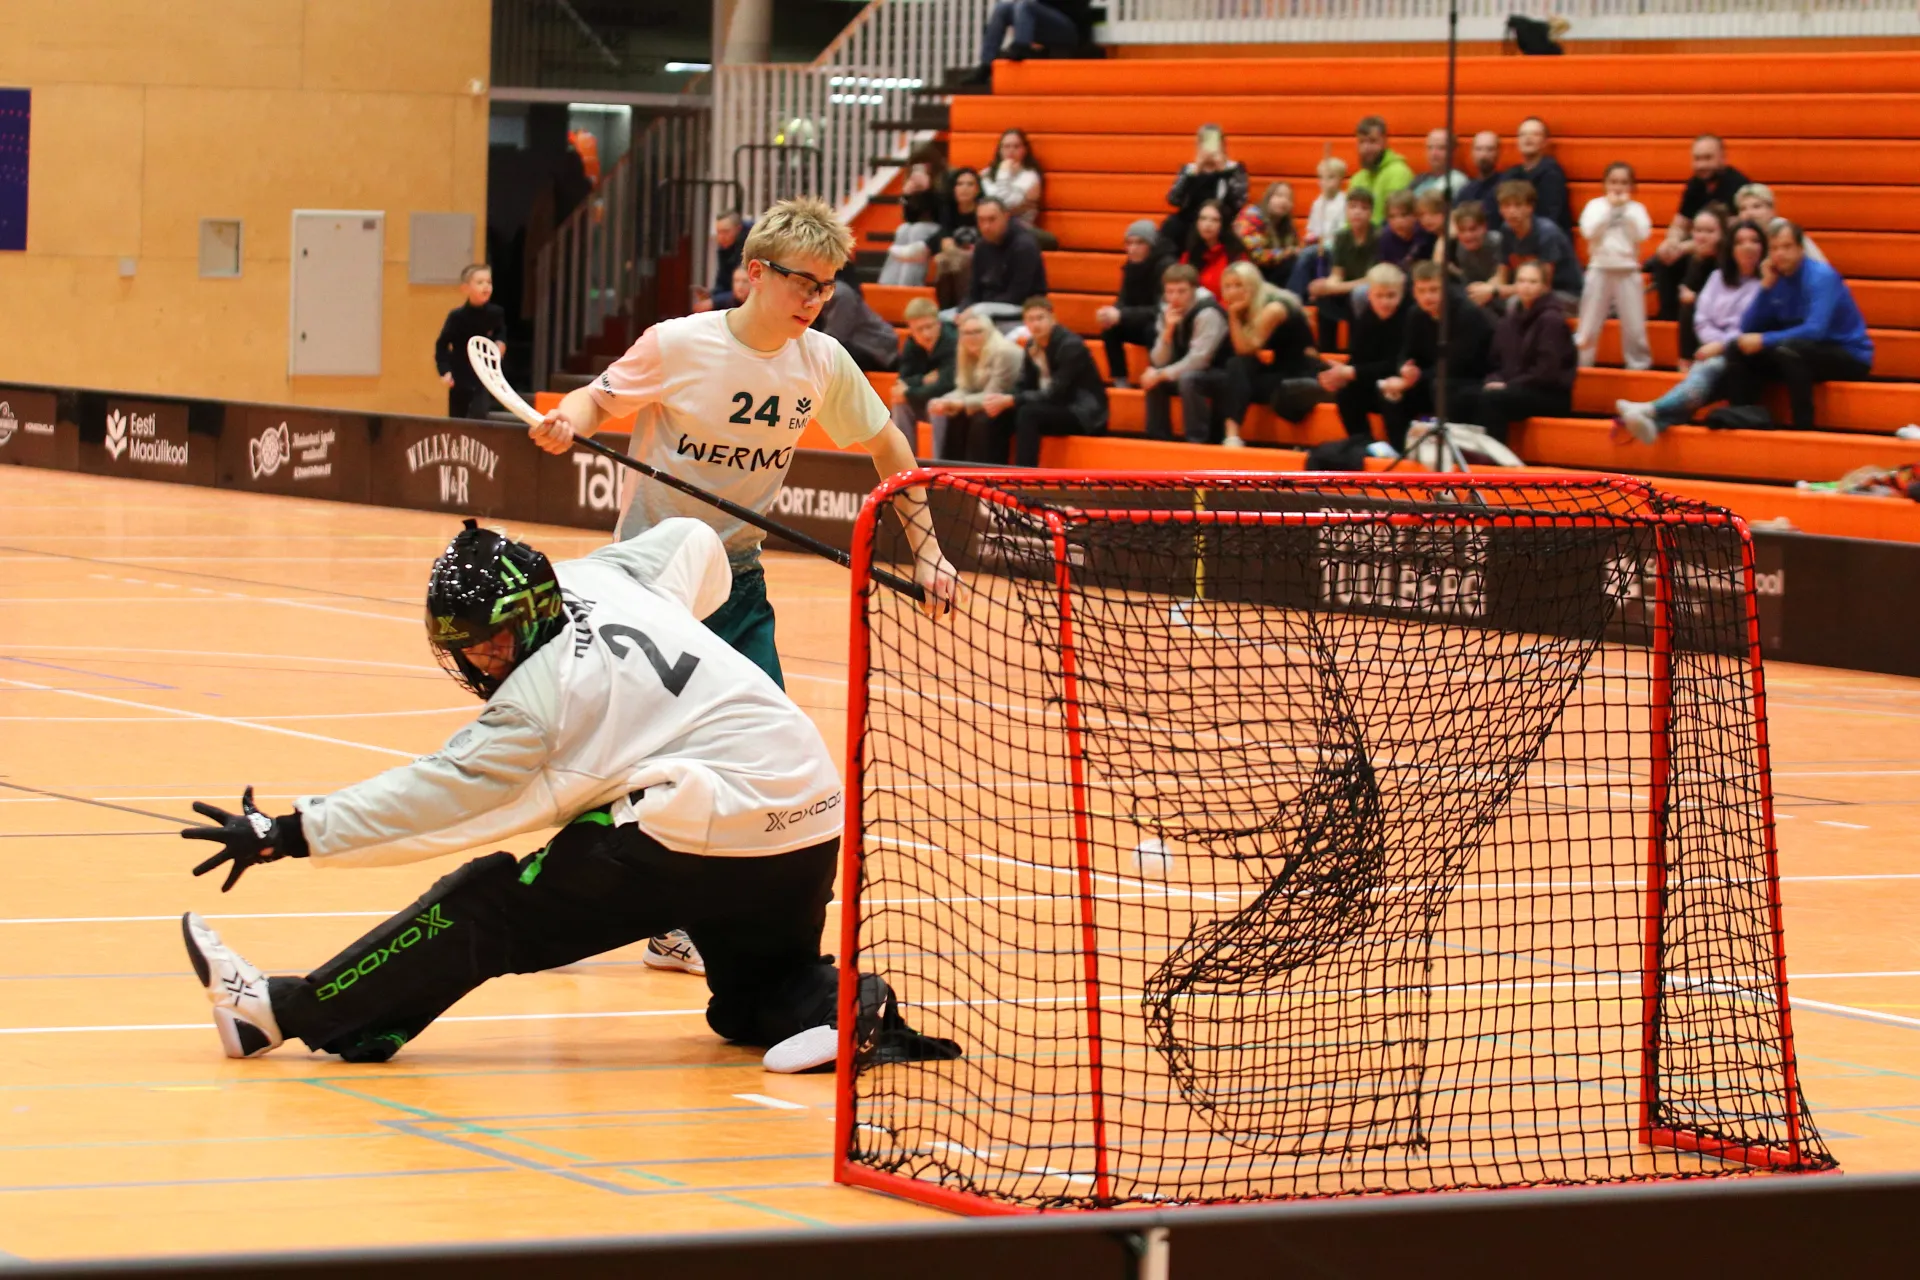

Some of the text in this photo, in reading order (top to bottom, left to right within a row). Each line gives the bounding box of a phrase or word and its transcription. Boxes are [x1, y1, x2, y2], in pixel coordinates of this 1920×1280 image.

[130, 412, 156, 436] Eesti
[728, 391, 781, 427] 24
[129, 438, 189, 464] Maaülikool
[406, 433, 499, 479] WILLY&RUDY
[677, 433, 793, 472] WERMO
[440, 465, 469, 504] W&R
[598, 623, 701, 698] 2
